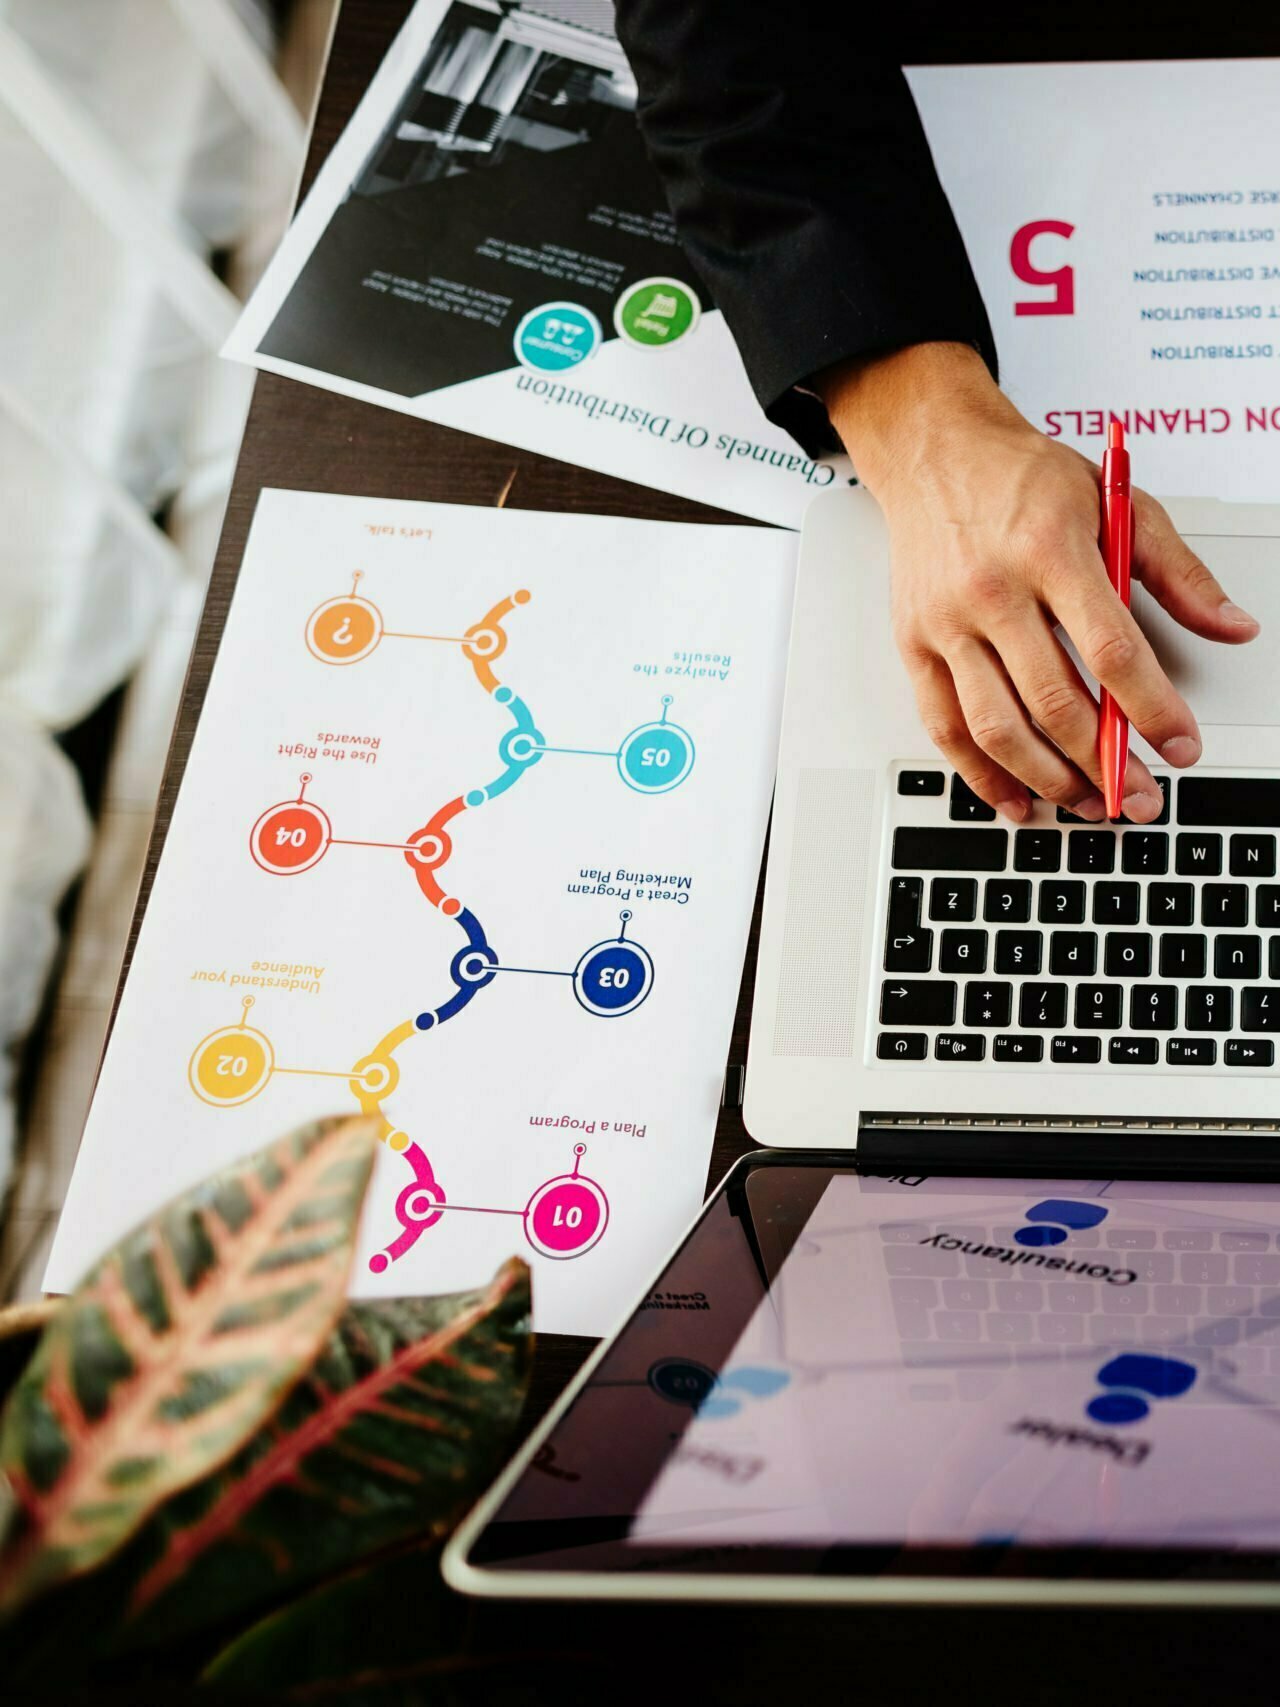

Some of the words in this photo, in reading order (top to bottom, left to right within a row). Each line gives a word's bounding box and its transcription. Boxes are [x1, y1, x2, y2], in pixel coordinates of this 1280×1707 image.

[1154, 193, 1242, 206] CHANNELS
[1155, 229, 1273, 244] DISTRIBUTION
[1009, 220, 1075, 316] 5
[1134, 268, 1253, 282] DISTRIBUTION
[1141, 306, 1261, 321] DISTRIBUTION
[524, 336, 587, 363] Consumer
[1151, 345, 1272, 360] DISTRIBUTION
[516, 373, 669, 436] Distribution
[1043, 409, 1230, 439] CHANNELS
[668, 419, 708, 447] Of
[717, 434, 835, 486] Channels
[365, 525, 395, 535] talk.
[400, 528, 432, 540] Let's
[674, 653, 731, 667] Results
[633, 664, 657, 676] the
[665, 665, 729, 680] Analyze
[318, 733, 380, 749] Rewards
[278, 744, 317, 758] Right
[323, 749, 345, 760] the
[351, 751, 376, 763] Use
[641, 748, 670, 767] 05
[276, 827, 306, 847] 04
[1193, 848, 1206, 860] M
[1248, 849, 1258, 861] N
[580, 870, 610, 885] Plan
[616, 871, 691, 889] Marketing
[568, 884, 630, 900] Program
[643, 890, 689, 904] Creat
[1113, 897, 1120, 909] L
[1166, 898, 1175, 909] K
[1222, 899, 1228, 911] J
[1068, 948, 1077, 960] P
[1123, 948, 1134, 961] O
[1233, 951, 1243, 963] U
[191, 970, 226, 983] your
[251, 961, 325, 978] Audience
[230, 975, 320, 993] Understand
[599, 968, 629, 988] 03
[1094, 992, 1103, 1004] 0
[1151, 993, 1158, 1005] 9
[1206, 994, 1214, 1006] 8
[1261, 995, 1268, 1007] 7
[217, 1056, 247, 1076] 02
[530, 1116, 595, 1133] Program
[601, 1122, 609, 1130] a
[614, 1123, 646, 1137] Plan
[553, 1206, 582, 1227] 01
[920, 1232, 1138, 1287] Consultancy
